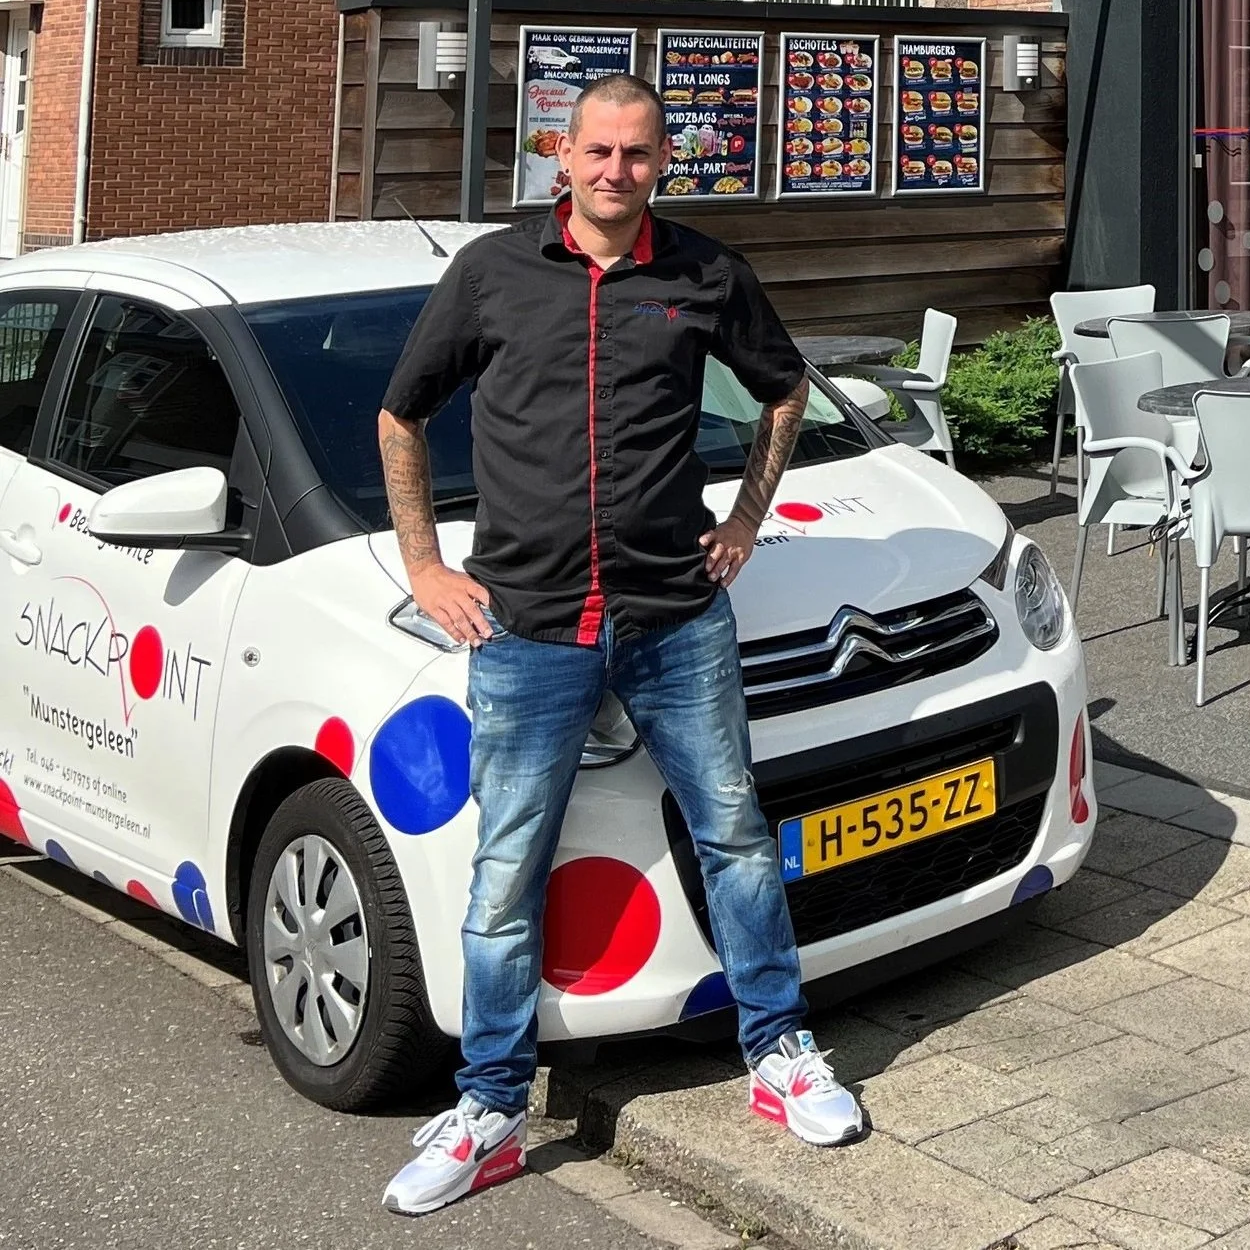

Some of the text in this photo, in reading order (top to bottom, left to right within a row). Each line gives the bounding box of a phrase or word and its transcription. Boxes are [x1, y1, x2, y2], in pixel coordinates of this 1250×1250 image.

[532, 34, 552, 42] MAAK
[553, 34, 567, 42] OOK
[597, 36, 611, 44] VAN
[613, 37, 629, 45] ONZE
[672, 37, 758, 49] VISSPECIALITEITEN
[793, 39, 837, 51] SCHOTELS
[571, 45, 622, 54] BEZORGSERVICE
[902, 44, 956, 56] HAMBURGERS
[699, 73, 731, 85] LONGS
[669, 112, 717, 124] KIDZBAGS
[667, 163, 727, 174] POM-A-PART
[15, 598, 212, 722] SNACKPOINT
[26, 747, 38, 765] Tel.
[40, 757, 54, 772] 046
[62, 766, 91, 792] 4517975
[92, 778, 101, 796] of
[102, 781, 128, 804] online
[23, 773, 152, 840] www.snackpoint-munstergeleen.nl
[819, 771, 983, 862] H-535-ZZ
[784, 855, 801, 872] NL
